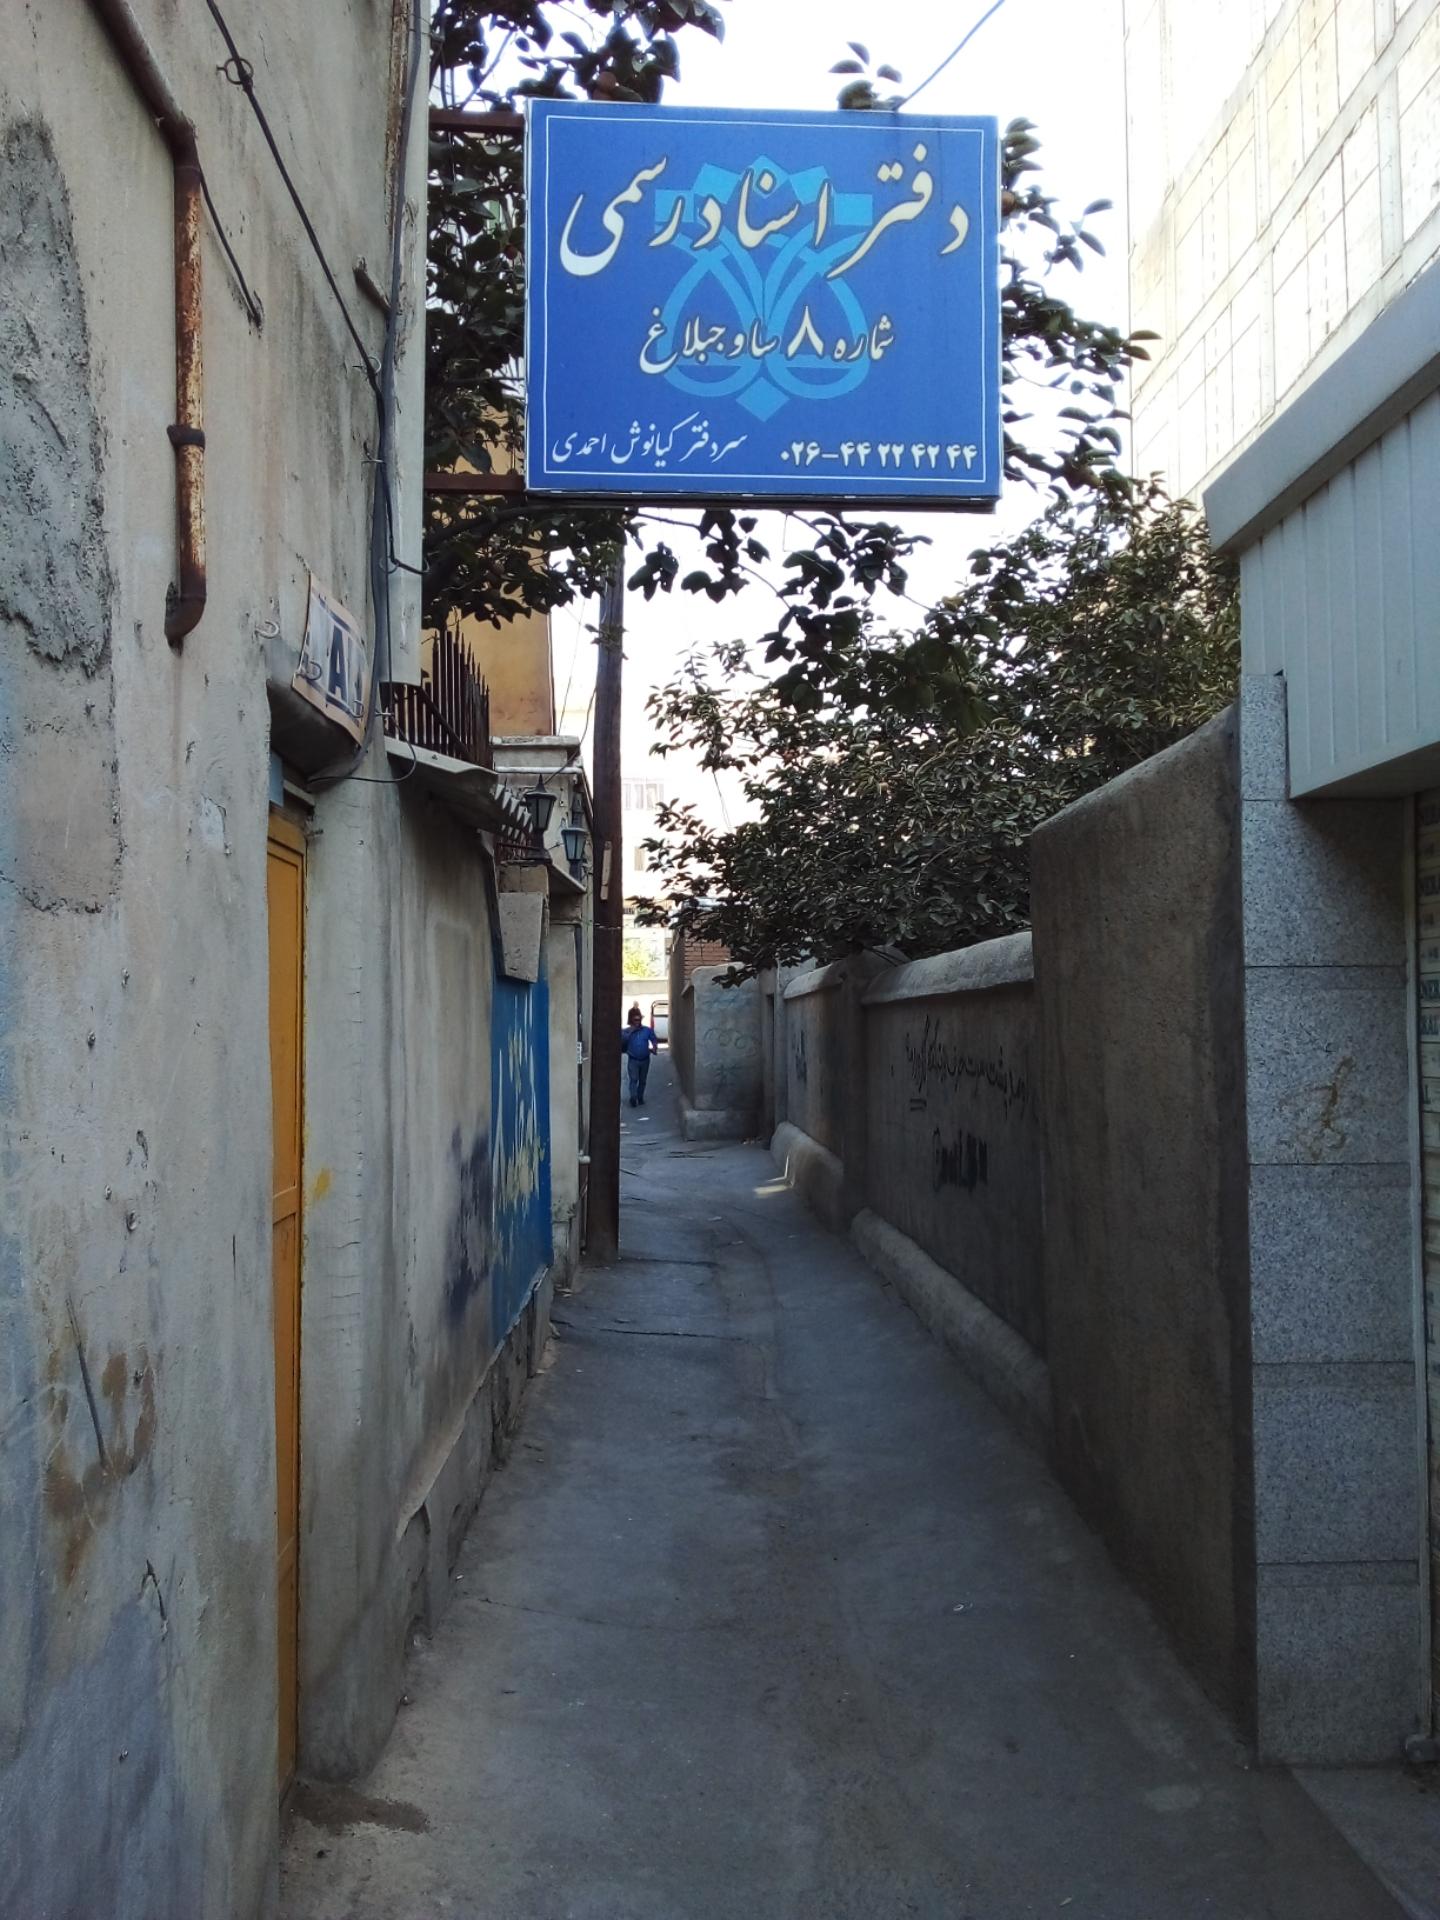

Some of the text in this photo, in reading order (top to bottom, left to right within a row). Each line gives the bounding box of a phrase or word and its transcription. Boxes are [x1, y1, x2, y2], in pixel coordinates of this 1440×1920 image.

[559, 142, 969, 279] دفتر اسناد رسمی
[786, 304, 825, 358] ۸
[832, 314, 895, 361] شماره
[552, 431, 608, 463] احمدی
[610, 411, 701, 468] کیانوش
